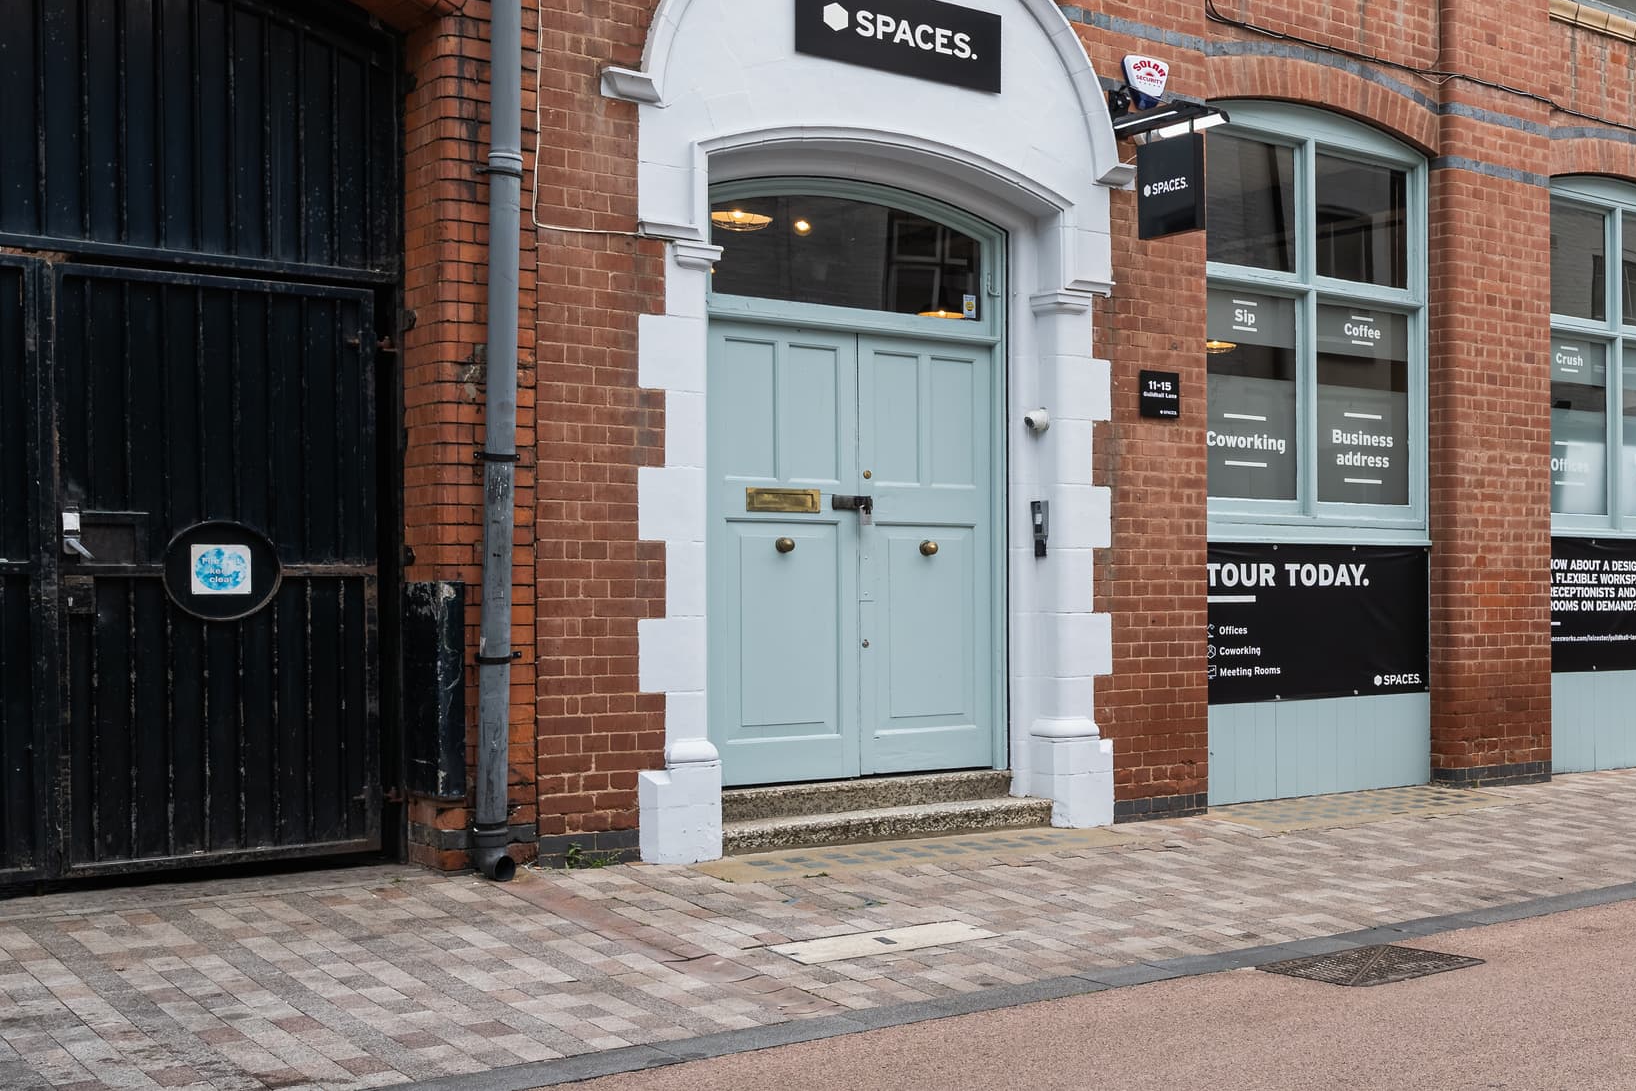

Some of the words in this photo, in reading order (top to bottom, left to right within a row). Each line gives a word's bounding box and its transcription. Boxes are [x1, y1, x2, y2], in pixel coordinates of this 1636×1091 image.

[855, 10, 978, 60] SPACES.
[1133, 60, 1166, 77] SOLAR
[1136, 75, 1163, 85] SECURITY
[1152, 176, 1189, 195] SPACES.
[1234, 309, 1256, 325] Sip
[1344, 322, 1381, 339] Coffee
[1556, 353, 1583, 367] Crush
[1148, 380, 1172, 391] 11-15
[1206, 431, 1286, 454] Coworking
[1332, 429, 1394, 447] Business
[1336, 452, 1390, 468] address
[1570, 560, 1600, 571] ABOUT
[1602, 561, 1610, 571] A
[1207, 563, 1276, 587] TOUR
[1285, 563, 1370, 587] TODAY.
[1556, 573, 1598, 584] FLEXIBLE
[1617, 587, 1636, 598] AND
[1581, 601, 1594, 611] ON
[1219, 626, 1248, 635] Offices
[1219, 645, 1261, 657] Coworking
[1220, 666, 1252, 678] Meeting
[1254, 666, 1281, 676] Rooms
[1383, 673, 1422, 686] SPACES.
